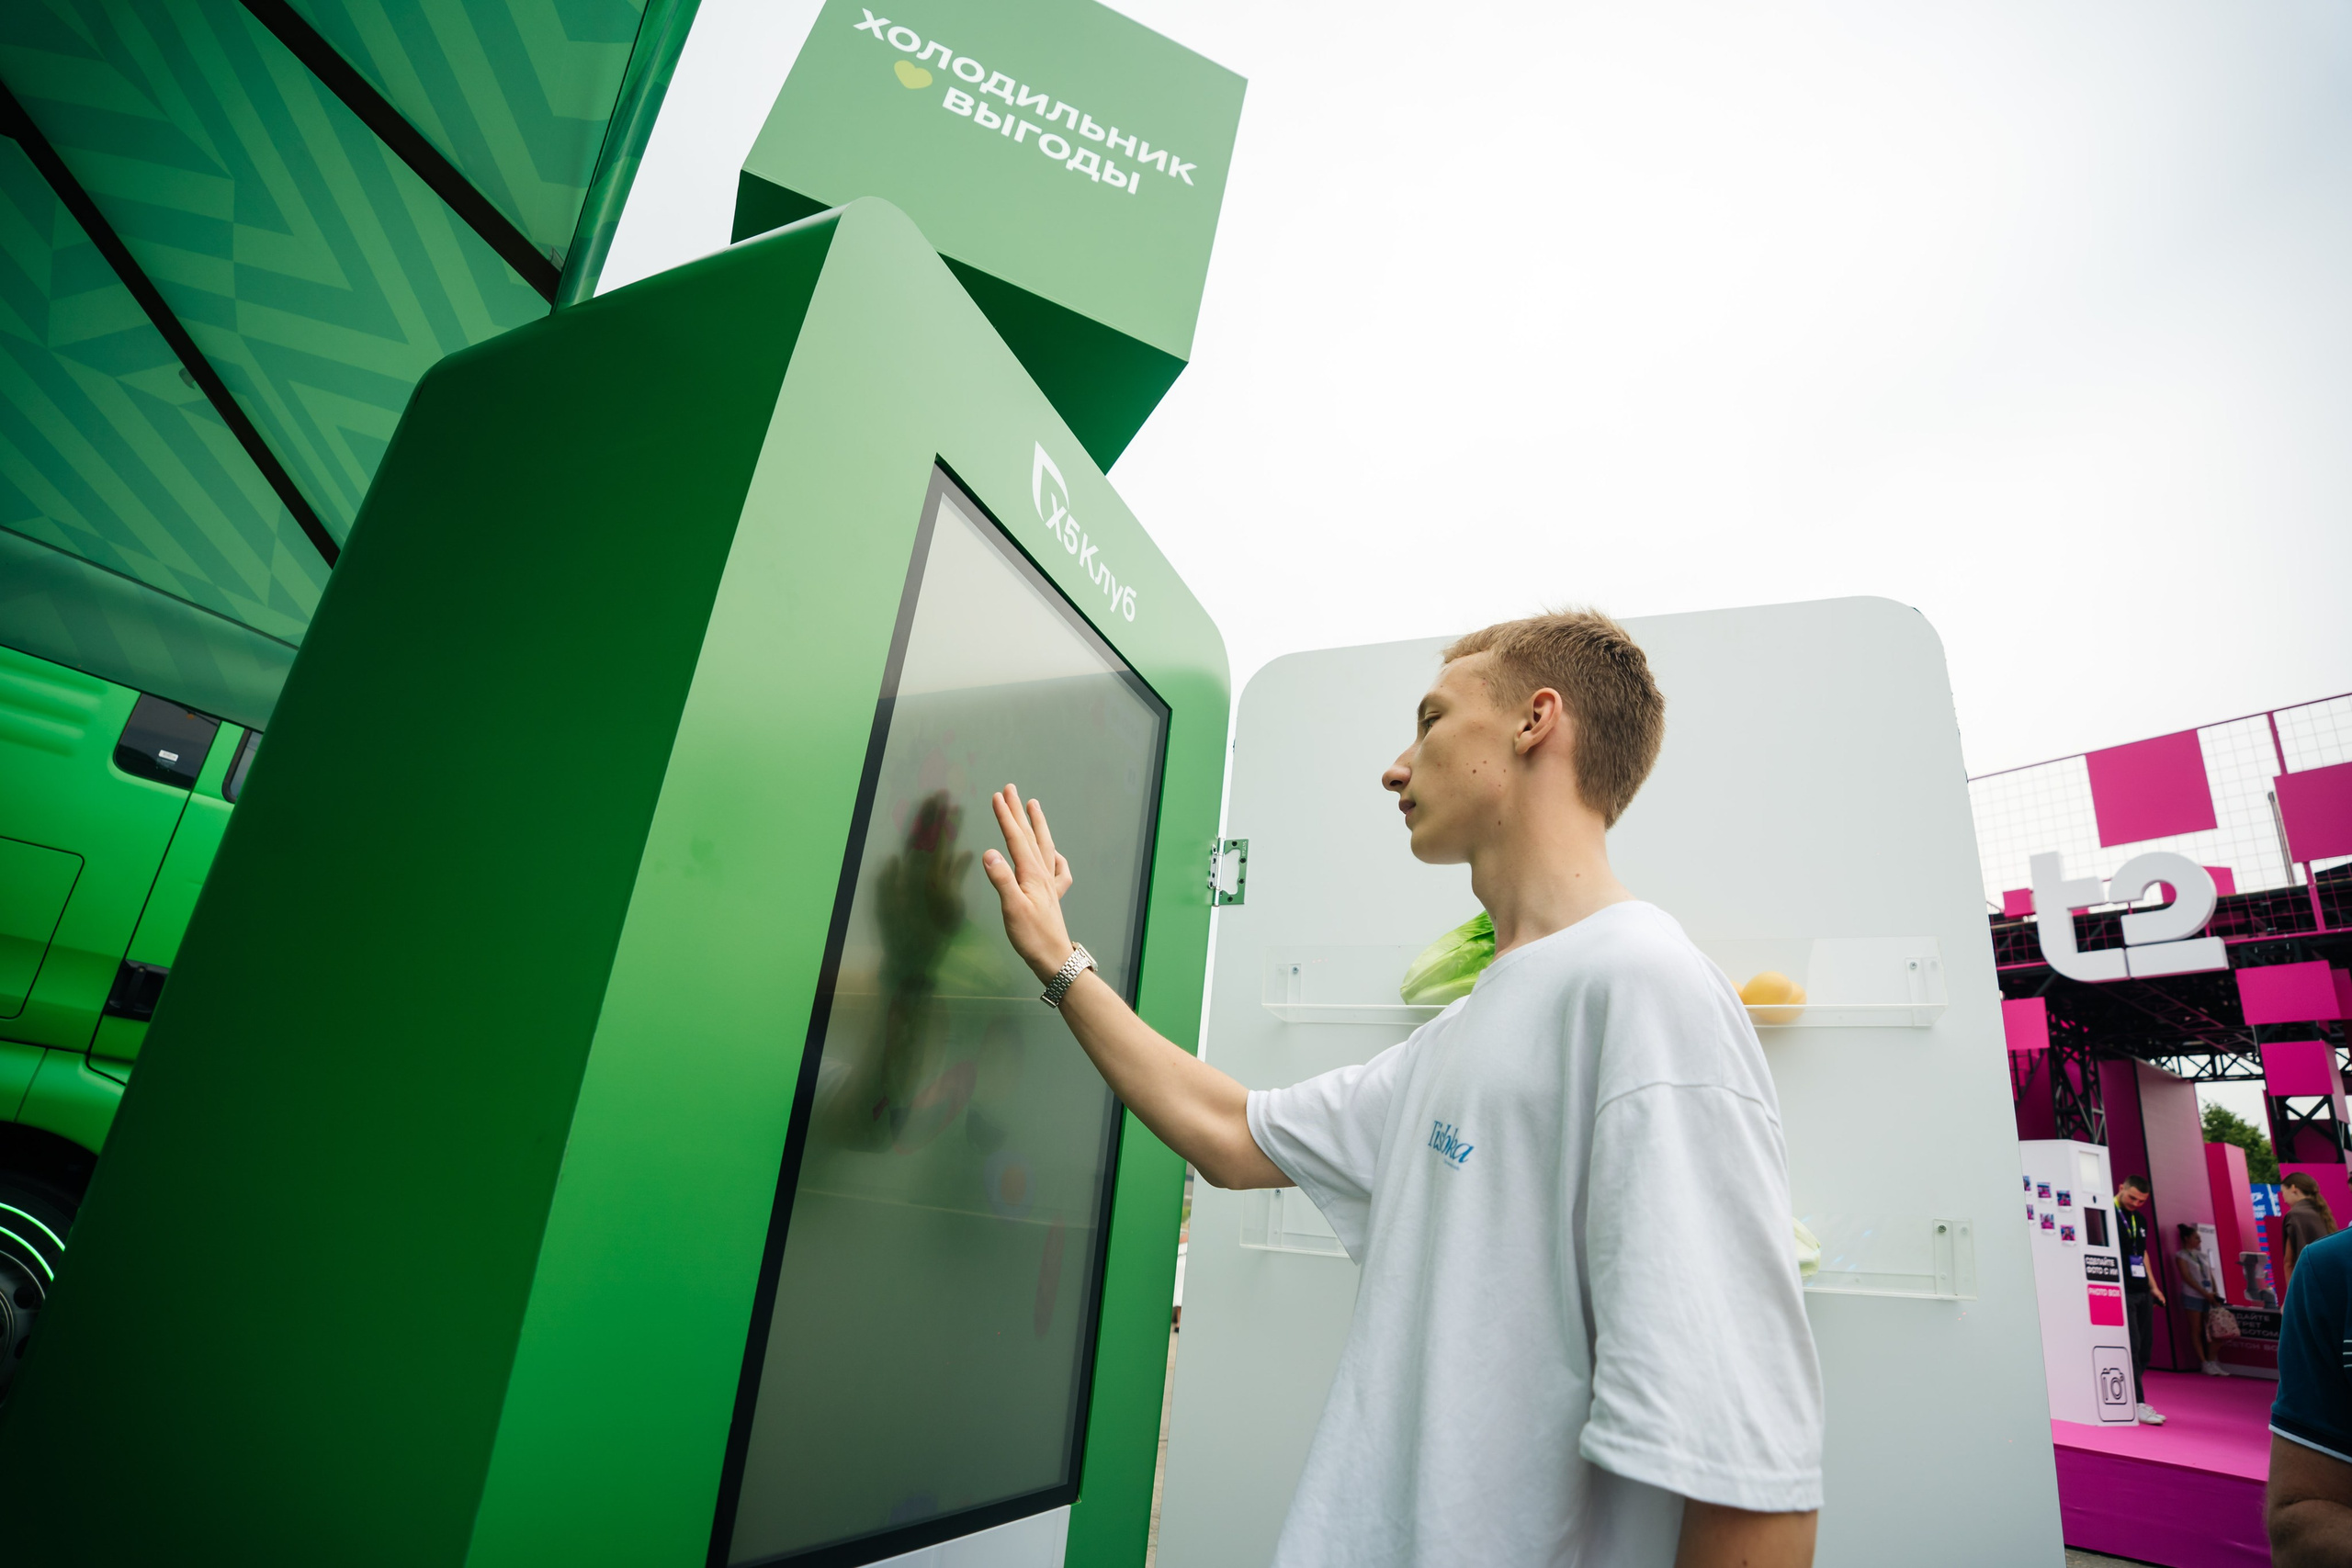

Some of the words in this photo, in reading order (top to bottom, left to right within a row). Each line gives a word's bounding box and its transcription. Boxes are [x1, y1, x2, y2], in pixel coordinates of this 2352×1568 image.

[853, 7, 1197, 186] ХОЛОДИЛЬНИК
[942, 86, 1140, 195] ВЫГОДЫ
[2030, 851, 2229, 984] t2
[2086, 1266, 2104, 1275] ФОТО
[2236, 1313, 2270, 1322] ДАЙТЕ
